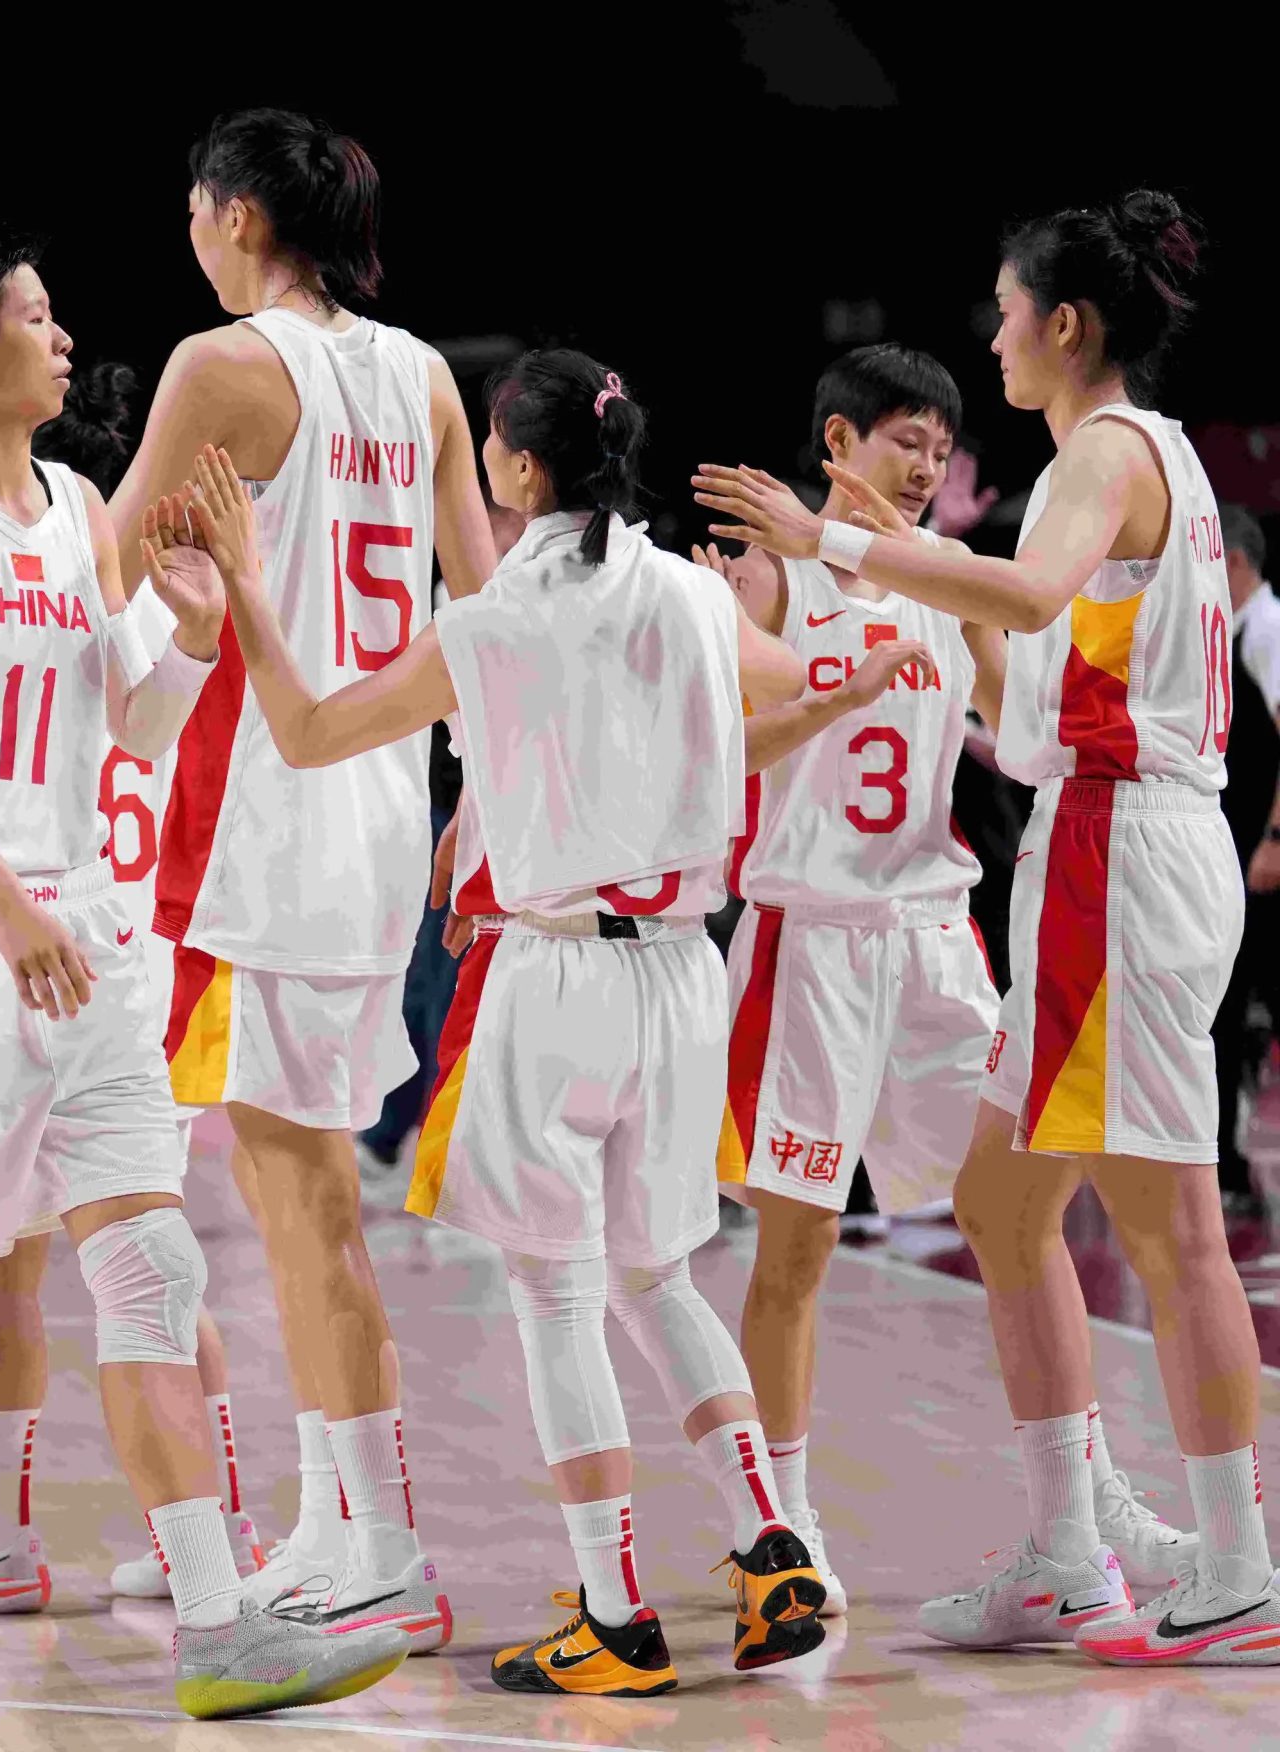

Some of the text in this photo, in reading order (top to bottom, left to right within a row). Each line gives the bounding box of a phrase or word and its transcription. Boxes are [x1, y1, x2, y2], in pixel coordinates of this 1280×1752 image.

[330, 519, 414, 672] 15
[99, 744, 158, 883] 6
[845, 726, 908, 834] 3
[26, 885, 58, 903] HN
[771, 1130, 843, 1183] 中国
